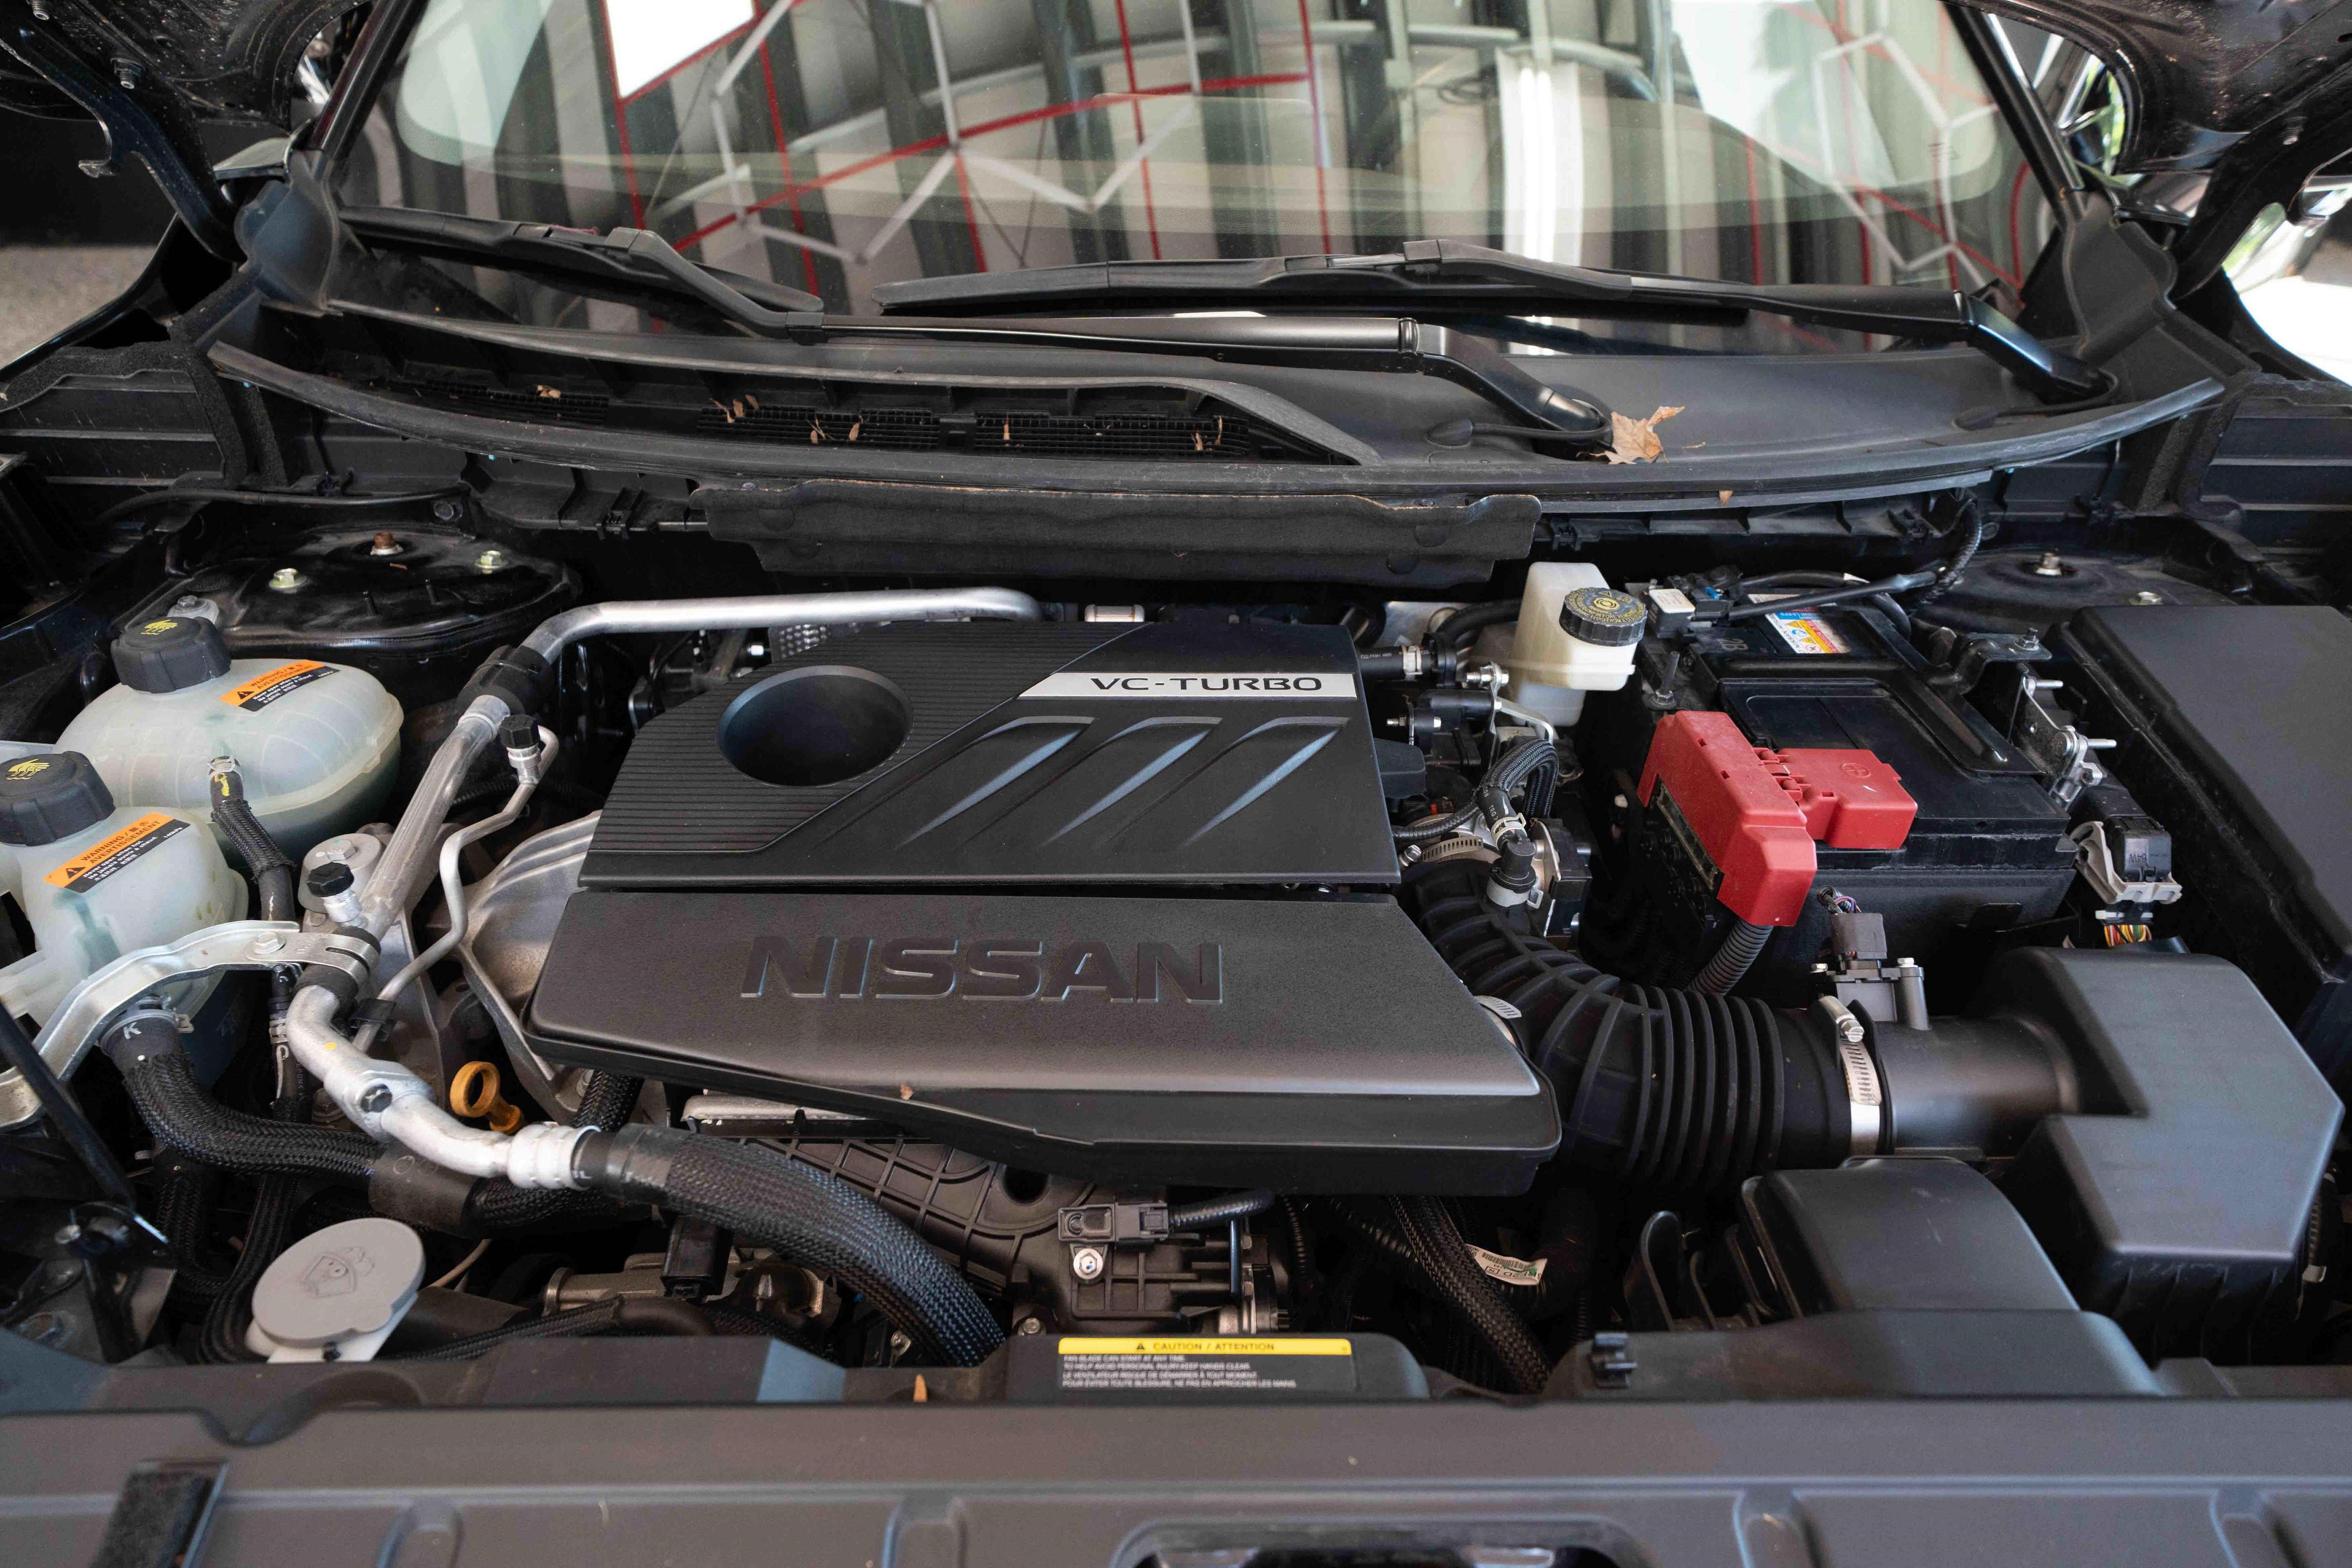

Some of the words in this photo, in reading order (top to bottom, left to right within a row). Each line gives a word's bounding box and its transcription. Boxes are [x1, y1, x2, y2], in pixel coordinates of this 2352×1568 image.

[1091, 678, 1322, 690] VC-TURBO
[80, 835, 125, 861] WARNING
[88, 820, 161, 864] AVERTISSEMENT
[82, 866, 102, 877] Never
[100, 856, 118, 866] open
[115, 846, 133, 856] when
[96, 861, 119, 873] jamais
[116, 850, 136, 861] ouvrir
[741, 936, 1223, 1004] NISSAN
[1154, 1343, 1202, 1351] CAUTION
